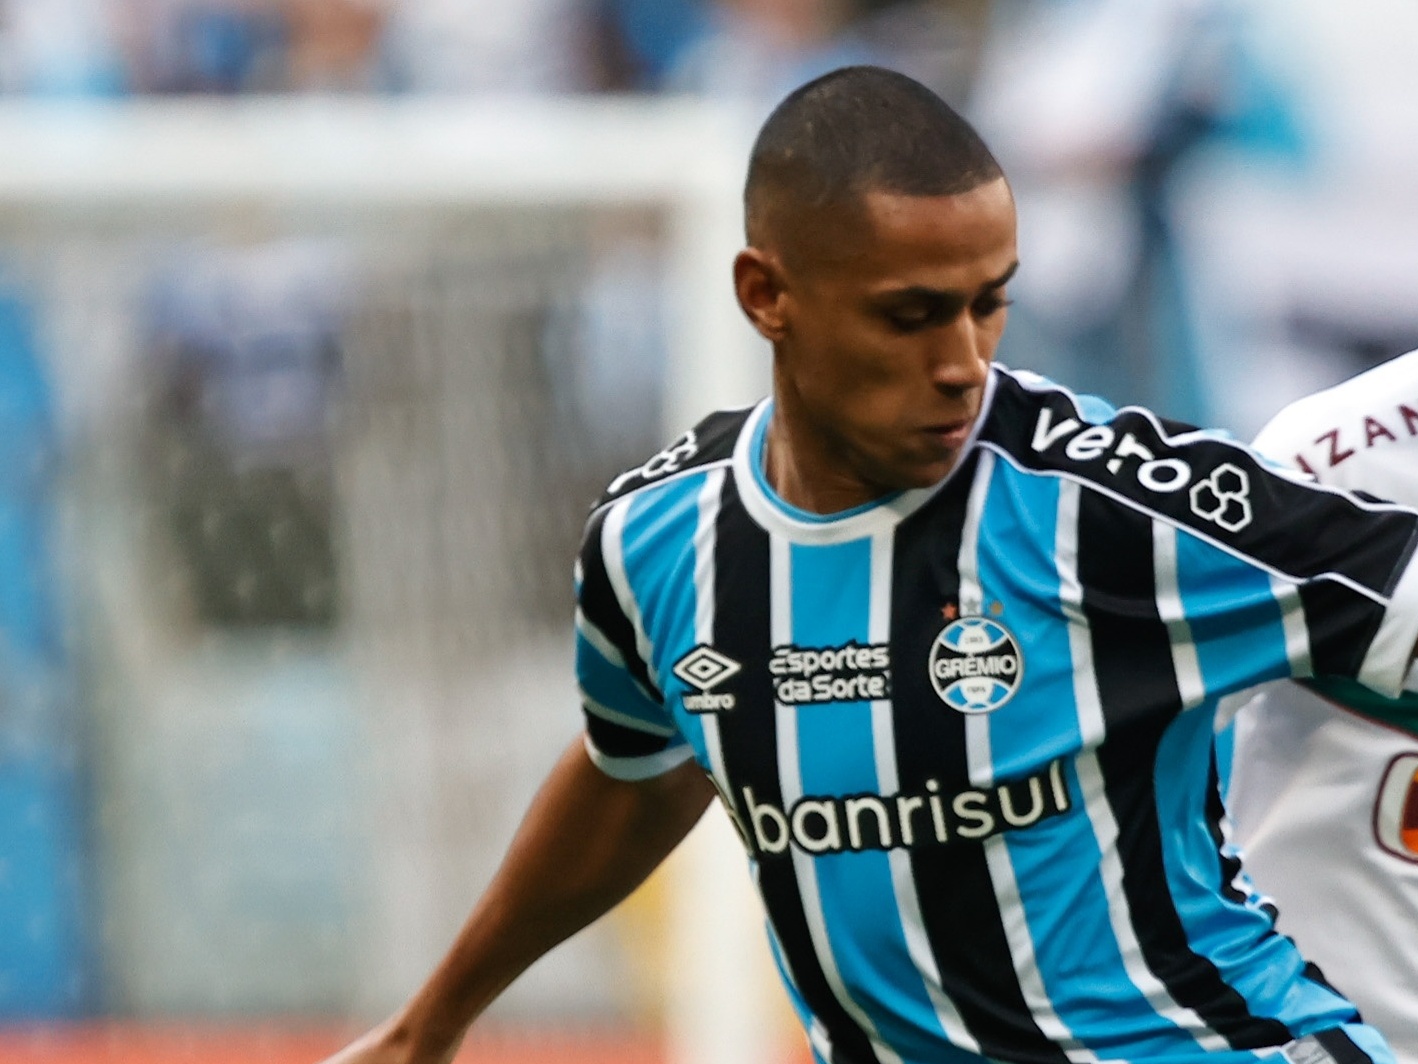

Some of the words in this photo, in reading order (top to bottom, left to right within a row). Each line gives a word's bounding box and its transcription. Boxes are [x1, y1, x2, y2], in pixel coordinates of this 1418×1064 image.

[1031, 407, 1192, 492] vero
[769, 645, 890, 677] Esportes
[683, 691, 736, 710] umbro
[742, 760, 1069, 852] banrisul
